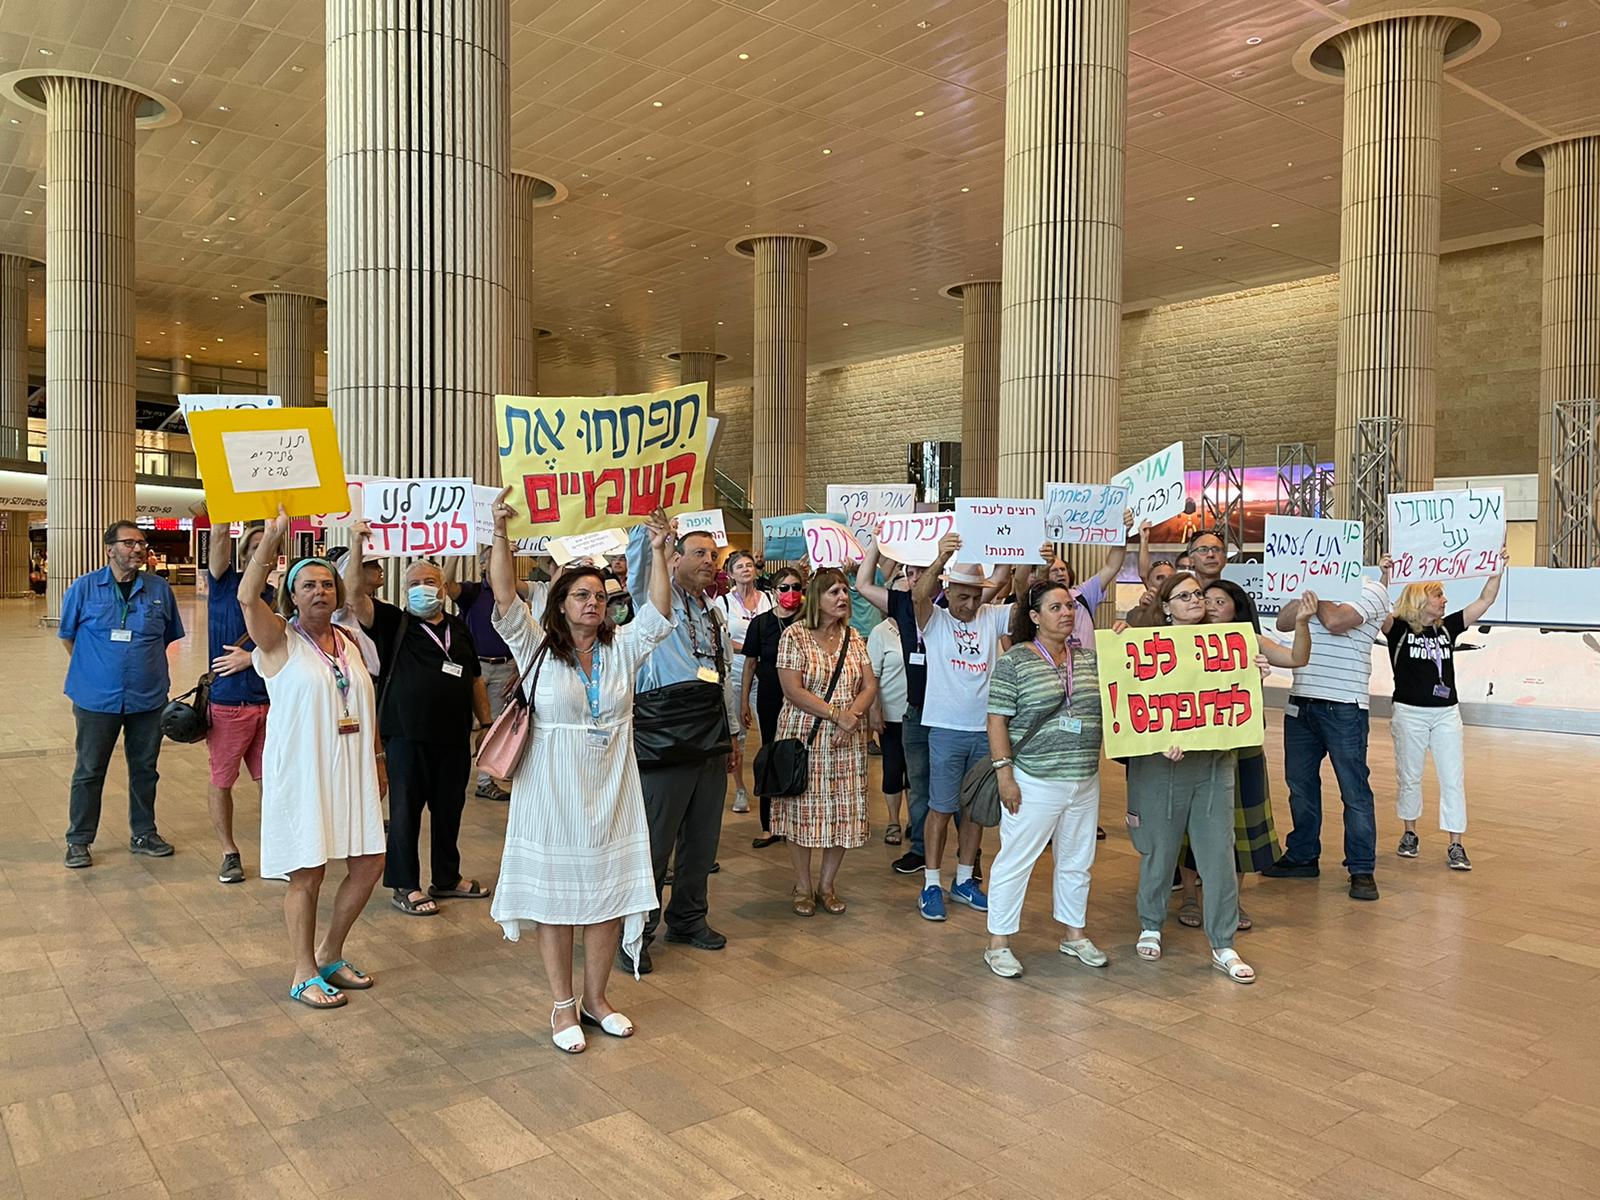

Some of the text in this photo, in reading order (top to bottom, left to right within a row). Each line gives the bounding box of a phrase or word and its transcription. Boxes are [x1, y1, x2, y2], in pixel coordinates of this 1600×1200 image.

[280, 435, 305, 448] תנו
[251, 466, 289, 478] להגיע
[523, 452, 697, 524] השמיים
[1047, 488, 1092, 514] האחרון
[1147, 481, 1183, 513] רוצה
[380, 482, 421, 524] לנו
[425, 486, 466, 521] תנו
[840, 490, 912, 517] מורי דרך
[970, 503, 1036, 516] רוצים לעבוד
[1394, 489, 1501, 527] אל תוותרו
[686, 516, 712, 528] איפה
[997, 524, 1012, 536] לא
[985, 545, 1025, 557] מתנות!
[1265, 528, 1313, 558] לעבוד
[1316, 535, 1342, 563] תנו
[1442, 522, 1469, 553] על
[1475, 550, 1499, 572] 24
[957, 642, 980, 655] אין
[1126, 632, 1248, 681] תנו לנו
